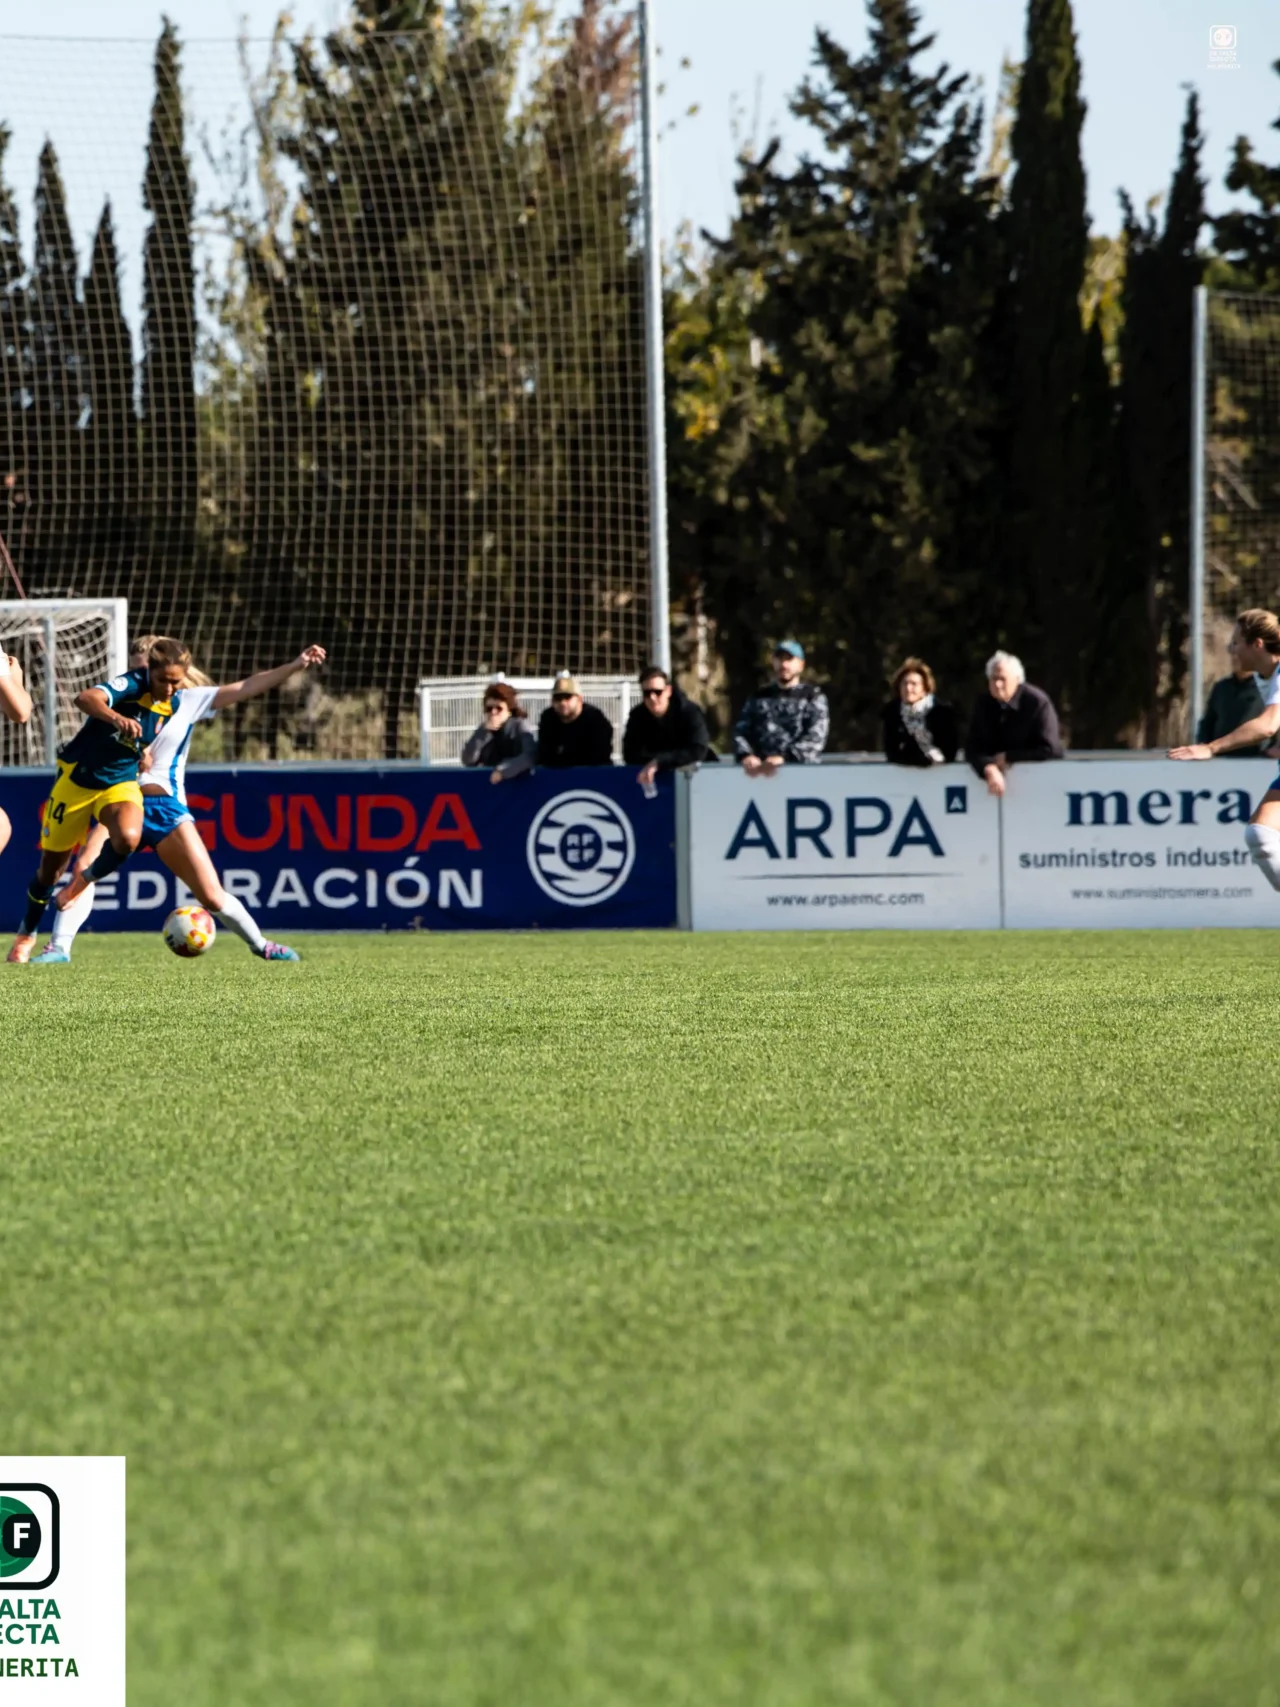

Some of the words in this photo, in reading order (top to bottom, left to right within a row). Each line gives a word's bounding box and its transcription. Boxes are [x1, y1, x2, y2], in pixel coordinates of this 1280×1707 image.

[1065, 788, 1252, 826] mera
[724, 797, 946, 860] ARPA
[1019, 849, 1157, 869] suministros
[1166, 847, 1252, 868] industr
[766, 892, 925, 907] www.arpaemc.com
